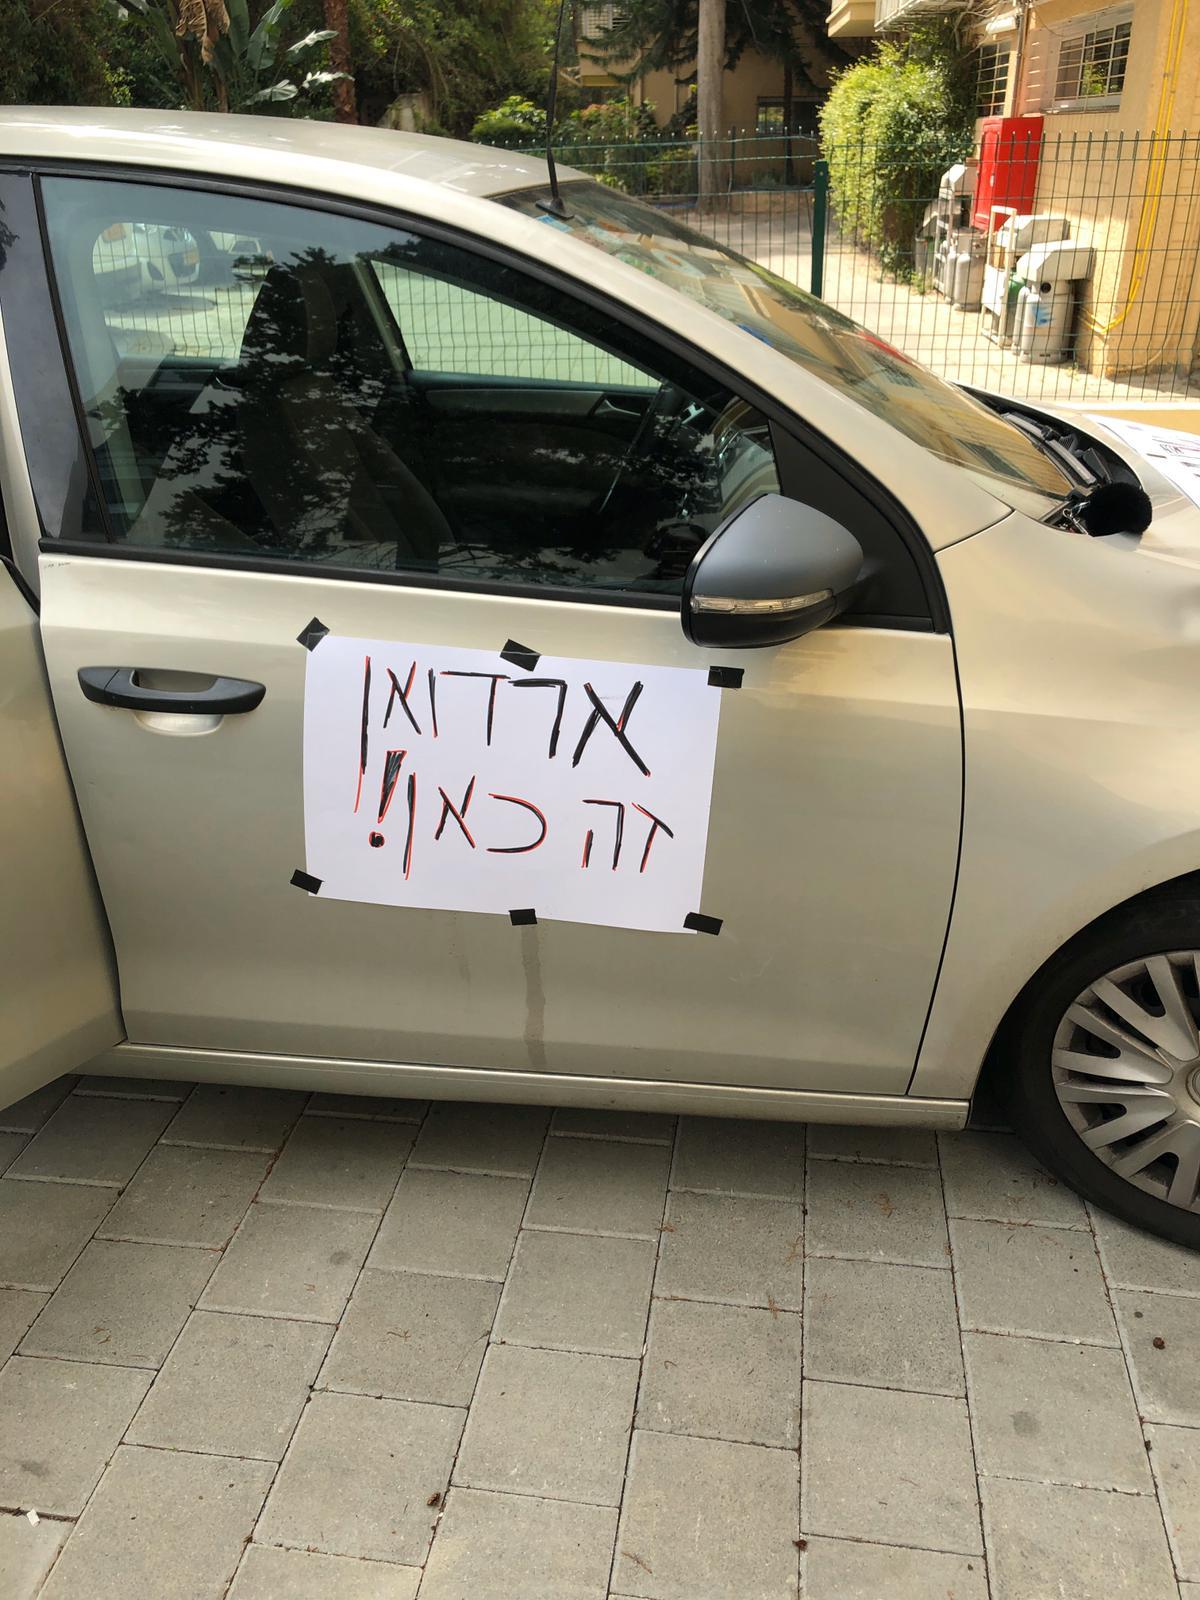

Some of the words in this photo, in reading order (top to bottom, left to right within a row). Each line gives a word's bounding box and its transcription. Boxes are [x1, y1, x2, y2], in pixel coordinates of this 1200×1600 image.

[354, 656, 651, 813] ארדואן
[369, 750, 547, 881] כאן!
[582, 799, 674, 873] זה
